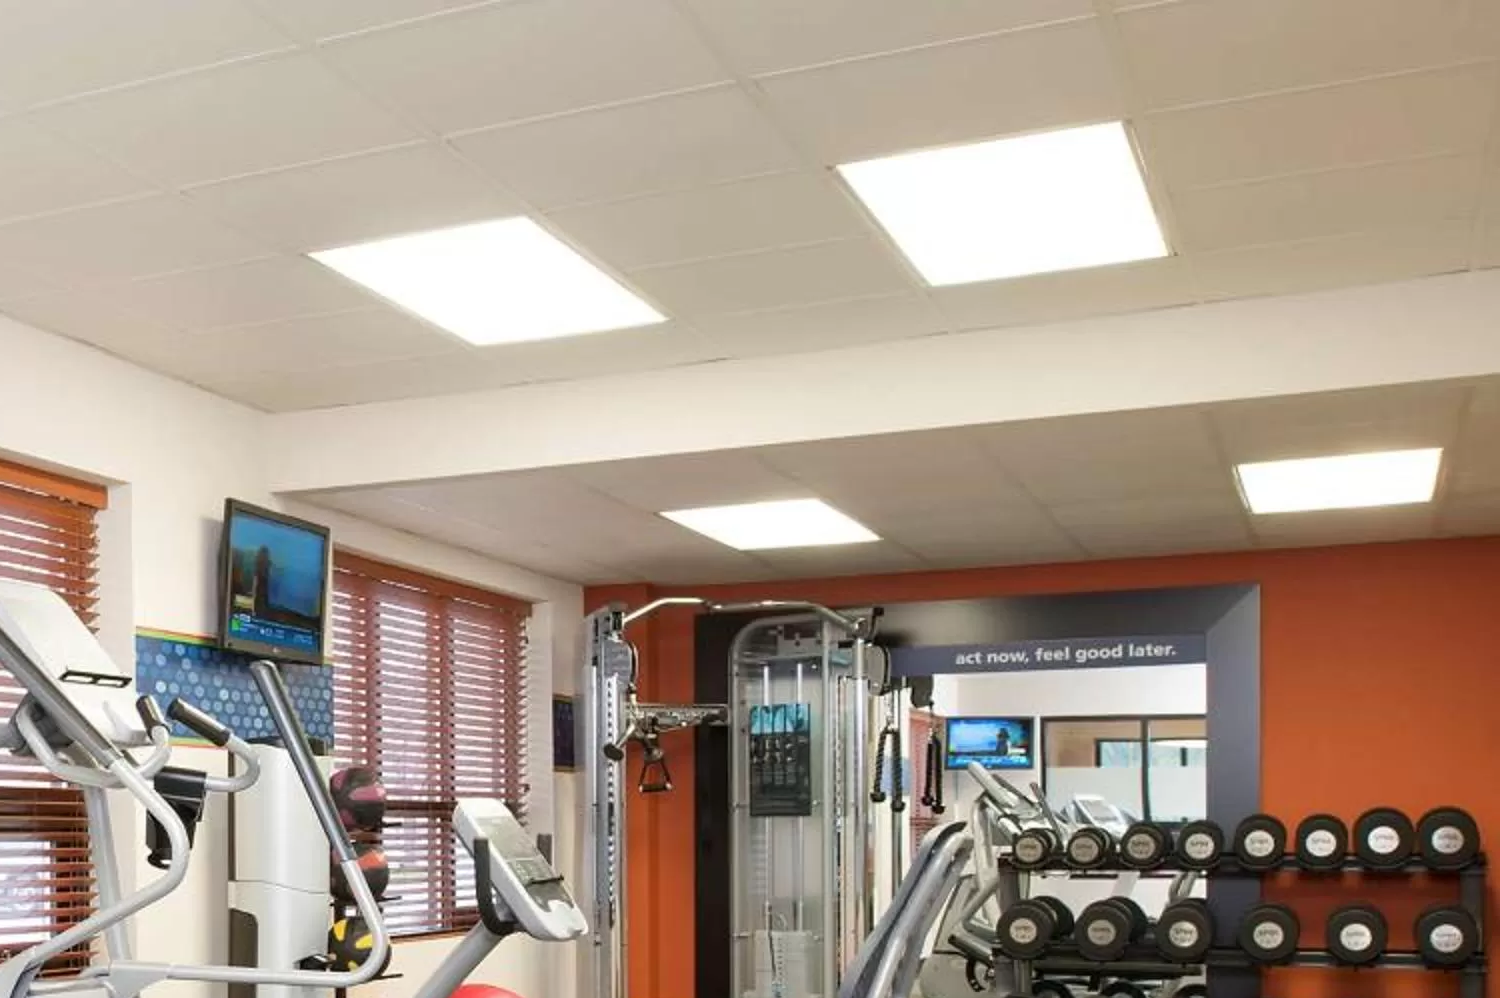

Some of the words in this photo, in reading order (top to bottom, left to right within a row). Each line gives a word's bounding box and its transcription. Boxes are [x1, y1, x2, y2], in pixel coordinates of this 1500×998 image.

[955, 651, 982, 665] act
[987, 651, 1029, 665] now,
[1035, 646, 1070, 662] feel
[1075, 643, 1123, 663] good
[1128, 643, 1177, 657] later.
